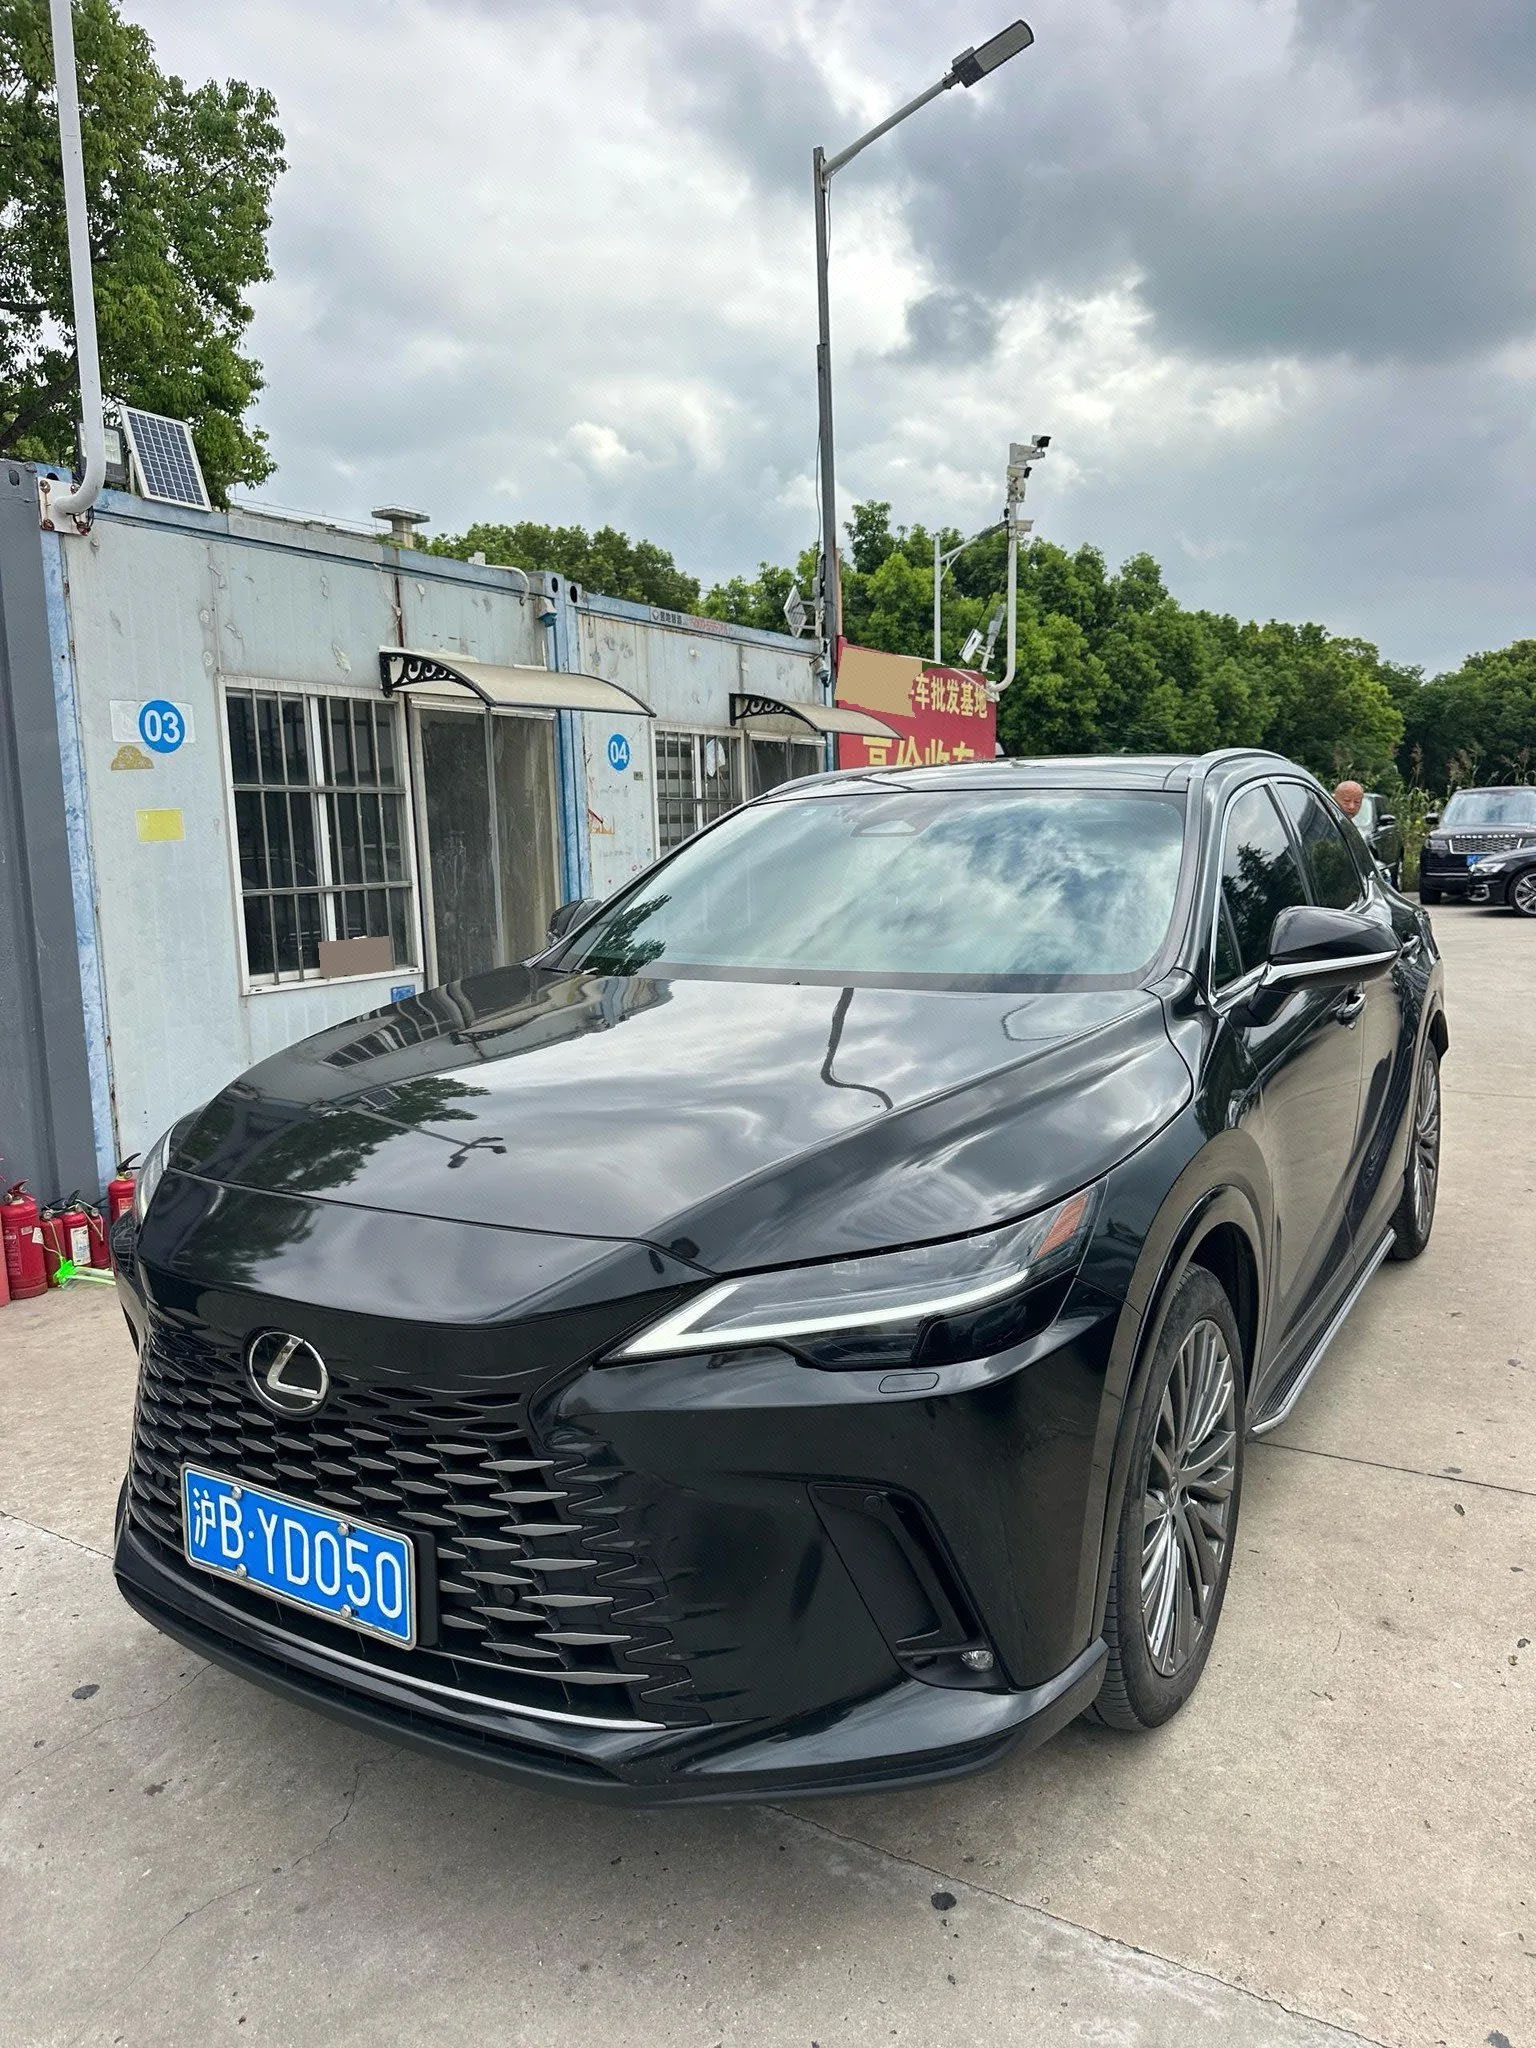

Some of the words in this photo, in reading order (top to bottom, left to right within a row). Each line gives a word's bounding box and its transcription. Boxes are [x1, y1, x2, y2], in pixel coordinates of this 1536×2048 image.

[909, 672, 988, 719] 车批发基地
[144, 709, 181, 744] 03
[610, 741, 629, 764] 04
[193, 1486, 404, 1620] 沪B·YD050
